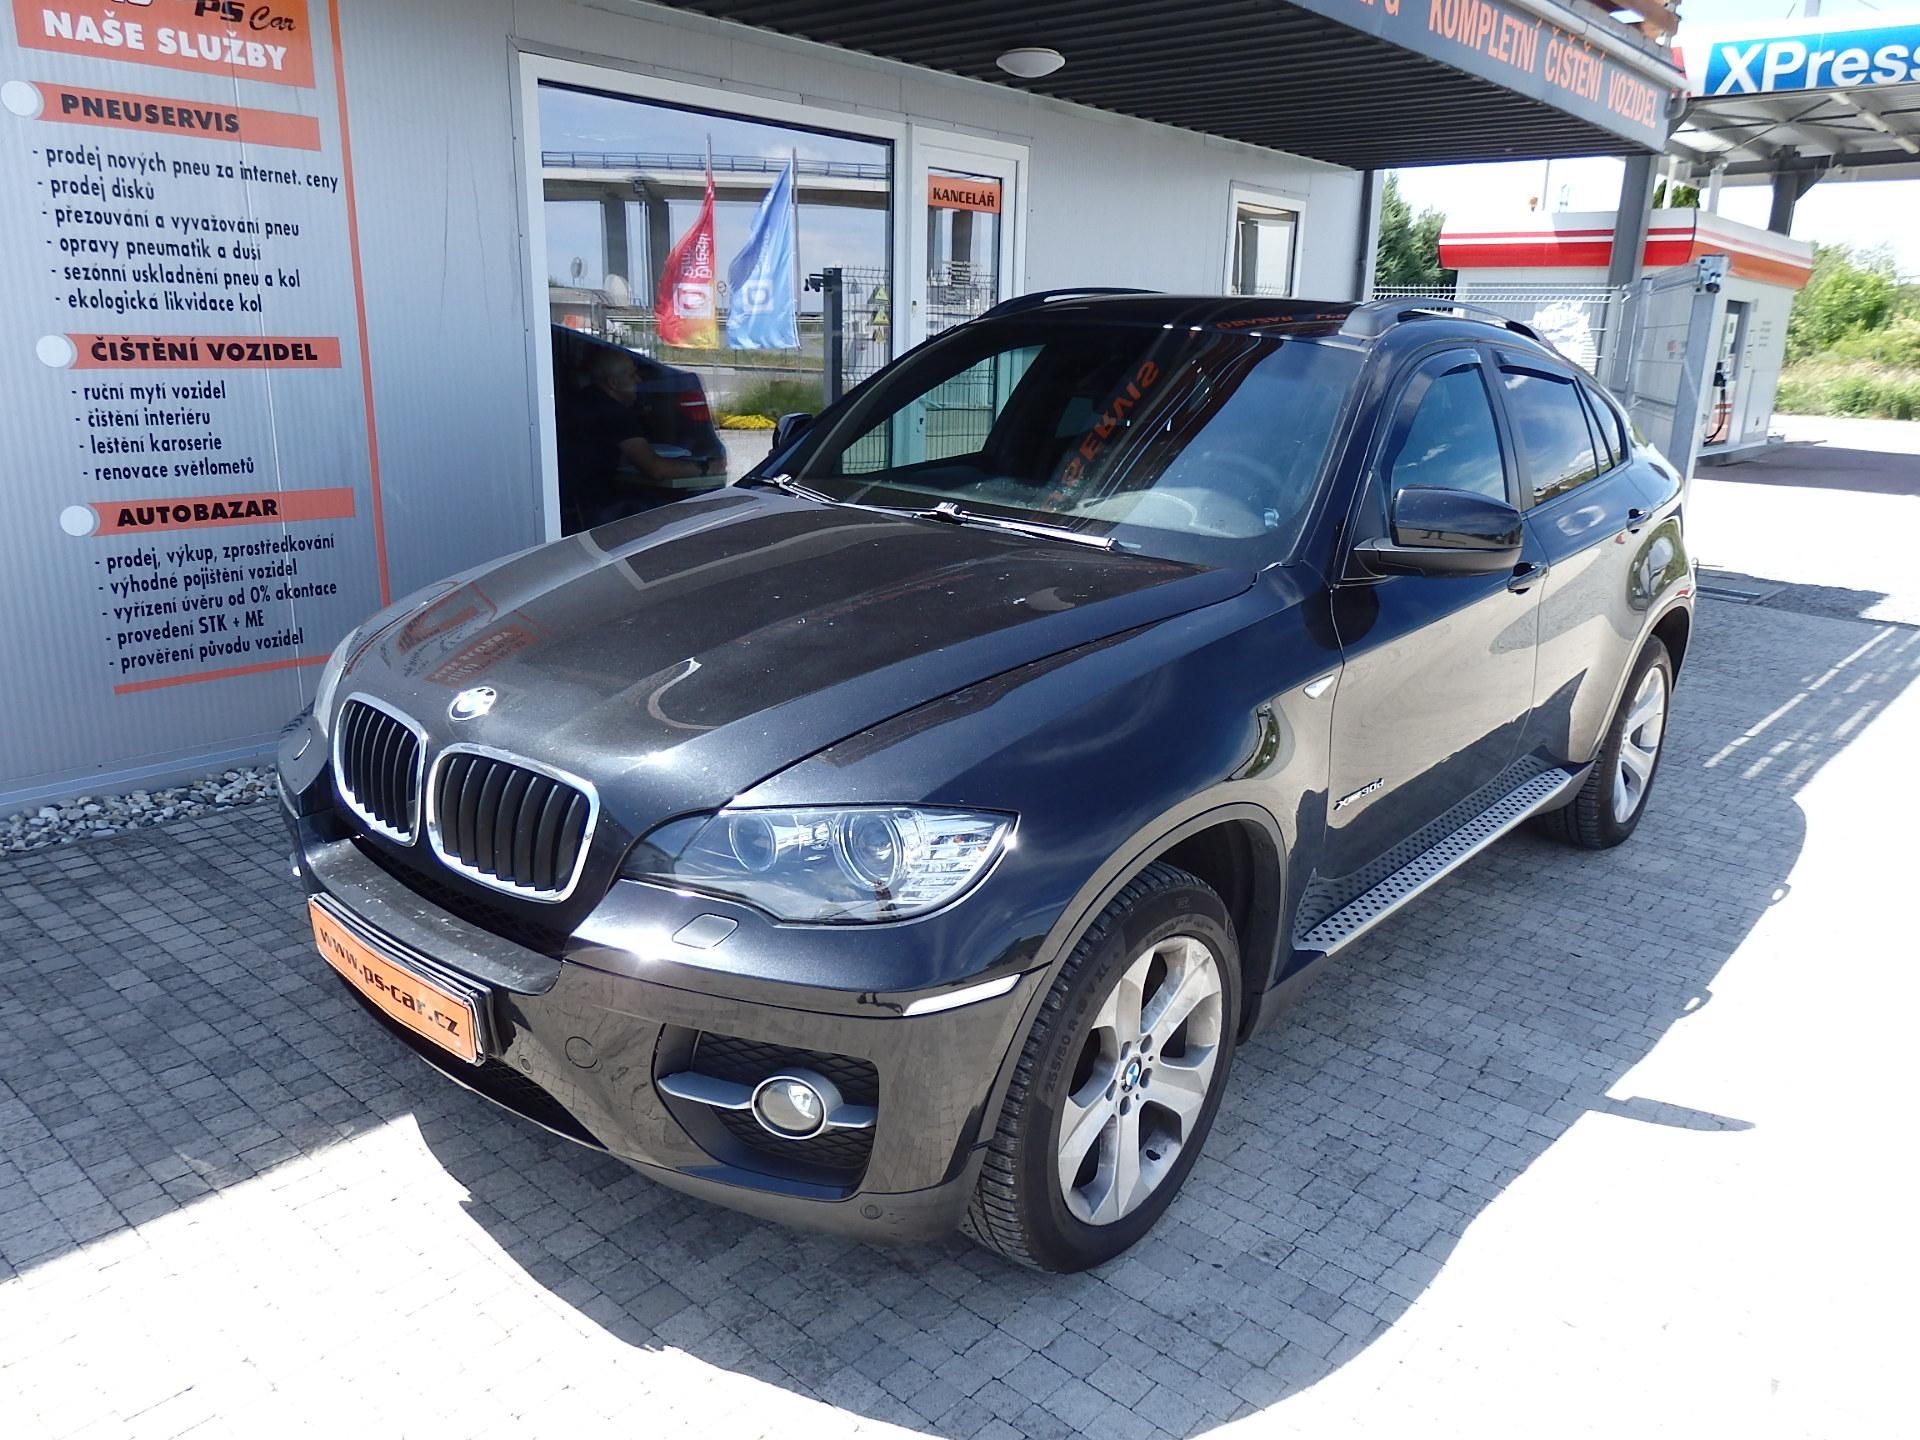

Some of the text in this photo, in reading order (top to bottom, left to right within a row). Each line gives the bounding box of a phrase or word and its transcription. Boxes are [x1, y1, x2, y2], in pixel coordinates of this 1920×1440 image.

[195, 0, 296, 31] PS Car
[43, 10, 287, 71] NAŠE SLUŽBY
[1428, 0, 1658, 129] KOMPLETNÍ ČIŠTĚNÍ VOZIDEL
[61, 93, 240, 133] PNEUSERVIS
[46, 144, 338, 193] prodej nových pneu za internet. ceny
[50, 174, 154, 202] prodej disků
[932, 187, 995, 207] KANCELÁŘ
[55, 205, 299, 239] přezouvání a vyvažování pneu
[60, 238, 261, 261] opravy pneumatik a duší
[64, 263, 300, 290] sezónní uskladnění pneu a kol
[68, 288, 262, 314] ekologická likvidace kol
[91, 336, 318, 361] ČIŠTĚNÍ VOZIDEL
[84, 380, 225, 404] ruční mytí vozidel
[88, 407, 210, 427] čištění interiéru
[90, 432, 222, 454] leštění karoserie
[95, 457, 254, 480] renovace světlometů
[117, 499, 278, 527] AUTOBAZAR
[107, 533, 334, 574] prodej, výkup, zprostředkování
[110, 558, 297, 600] výhodné pojištění vozidel
[114, 583, 336, 623] vyřízení úvěru od 0% akontace
[118, 620, 194, 650] provedení
[199, 614, 227, 633] STK
[246, 610, 264, 628] ME
[121, 627, 303, 674] prověření původu vozidel
[320, 927, 460, 1037] www.ps-car.cz
